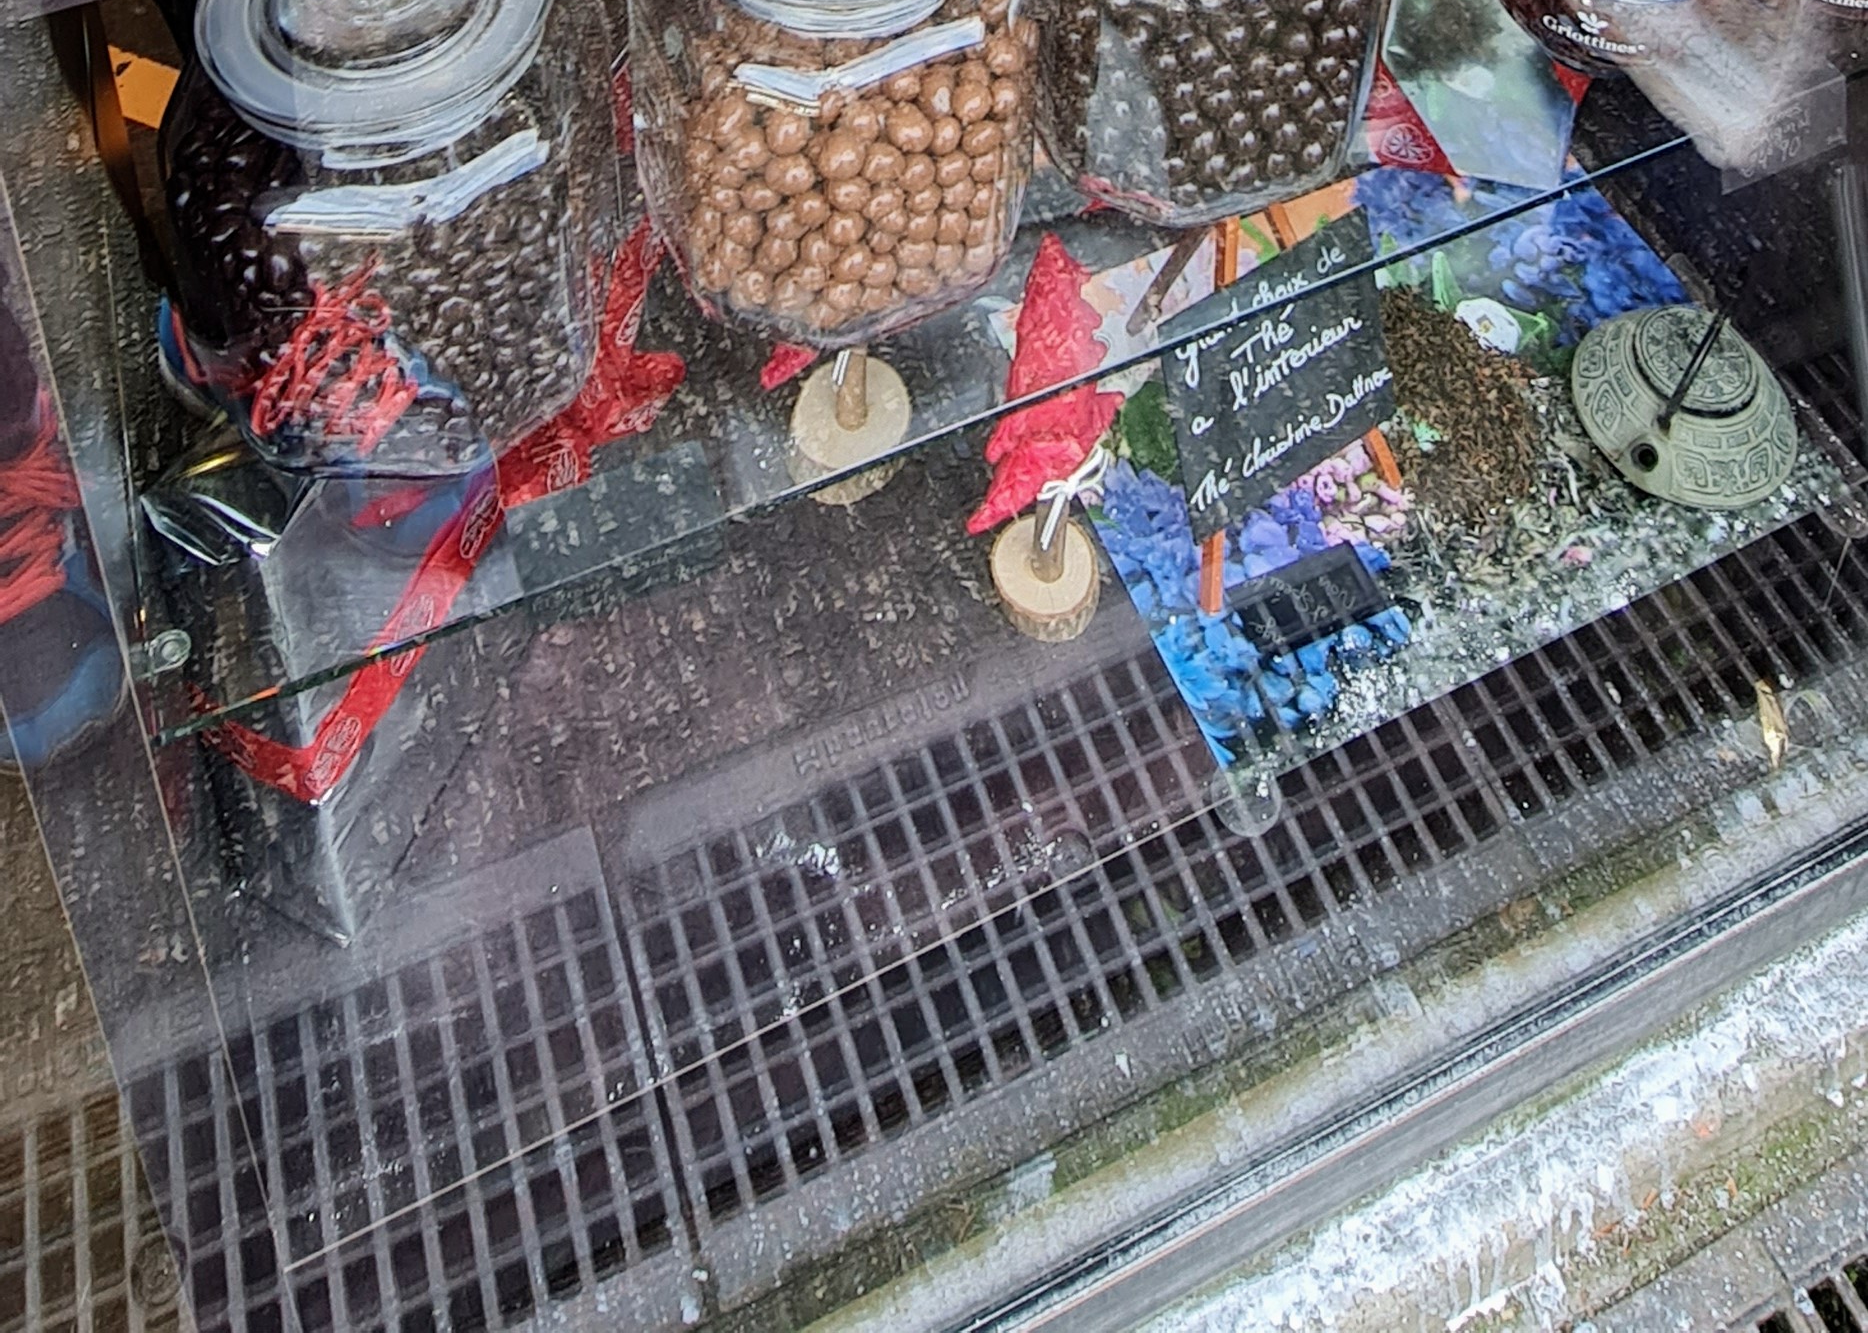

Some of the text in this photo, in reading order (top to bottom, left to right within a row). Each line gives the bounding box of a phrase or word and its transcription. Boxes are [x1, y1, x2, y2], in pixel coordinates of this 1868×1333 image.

[1541, 14, 1639, 55] Griottines
[1316, 244, 1347, 275] de
[1229, 303, 1296, 364] Thé
[1189, 456, 1233, 512] Thé
